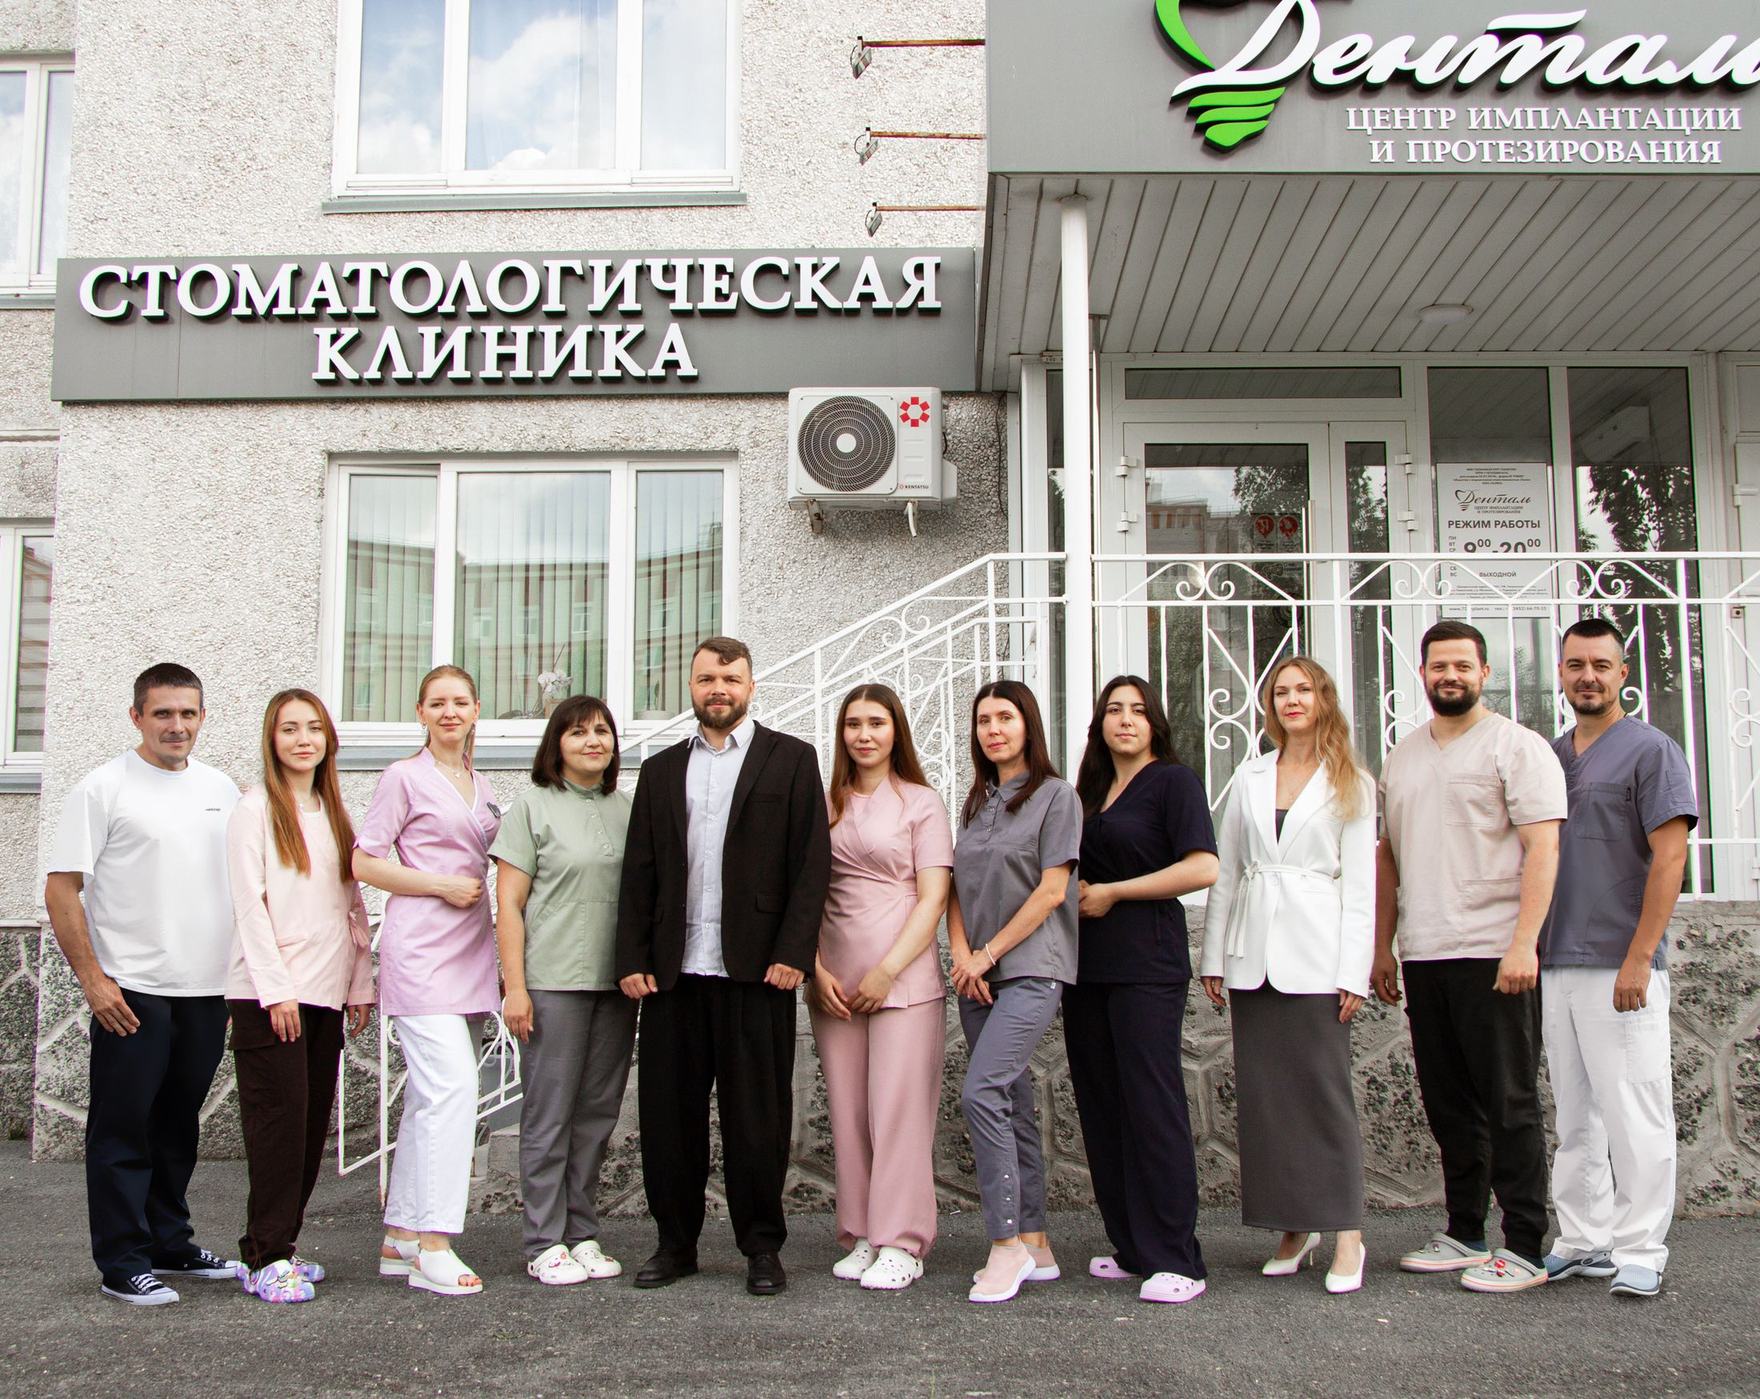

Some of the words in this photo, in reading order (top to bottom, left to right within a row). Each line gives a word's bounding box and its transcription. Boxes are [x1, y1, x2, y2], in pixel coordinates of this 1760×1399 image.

[1346, 107, 1457, 134] ЦЕНТР
[1467, 107, 1742, 134] ИМПЛАНТАЦИИ
[1369, 140, 1394, 163] И
[1406, 139, 1722, 163] ПРОТЕЗИРОВАНИЯ
[79, 256, 942, 318] СТОМАТОЛОГИЧЕСКАЯ
[311, 323, 699, 381] КЛИНИКА
[1448, 520, 1491, 528] РЕЖИМ
[1494, 520, 1541, 528] РАБОТЫ
